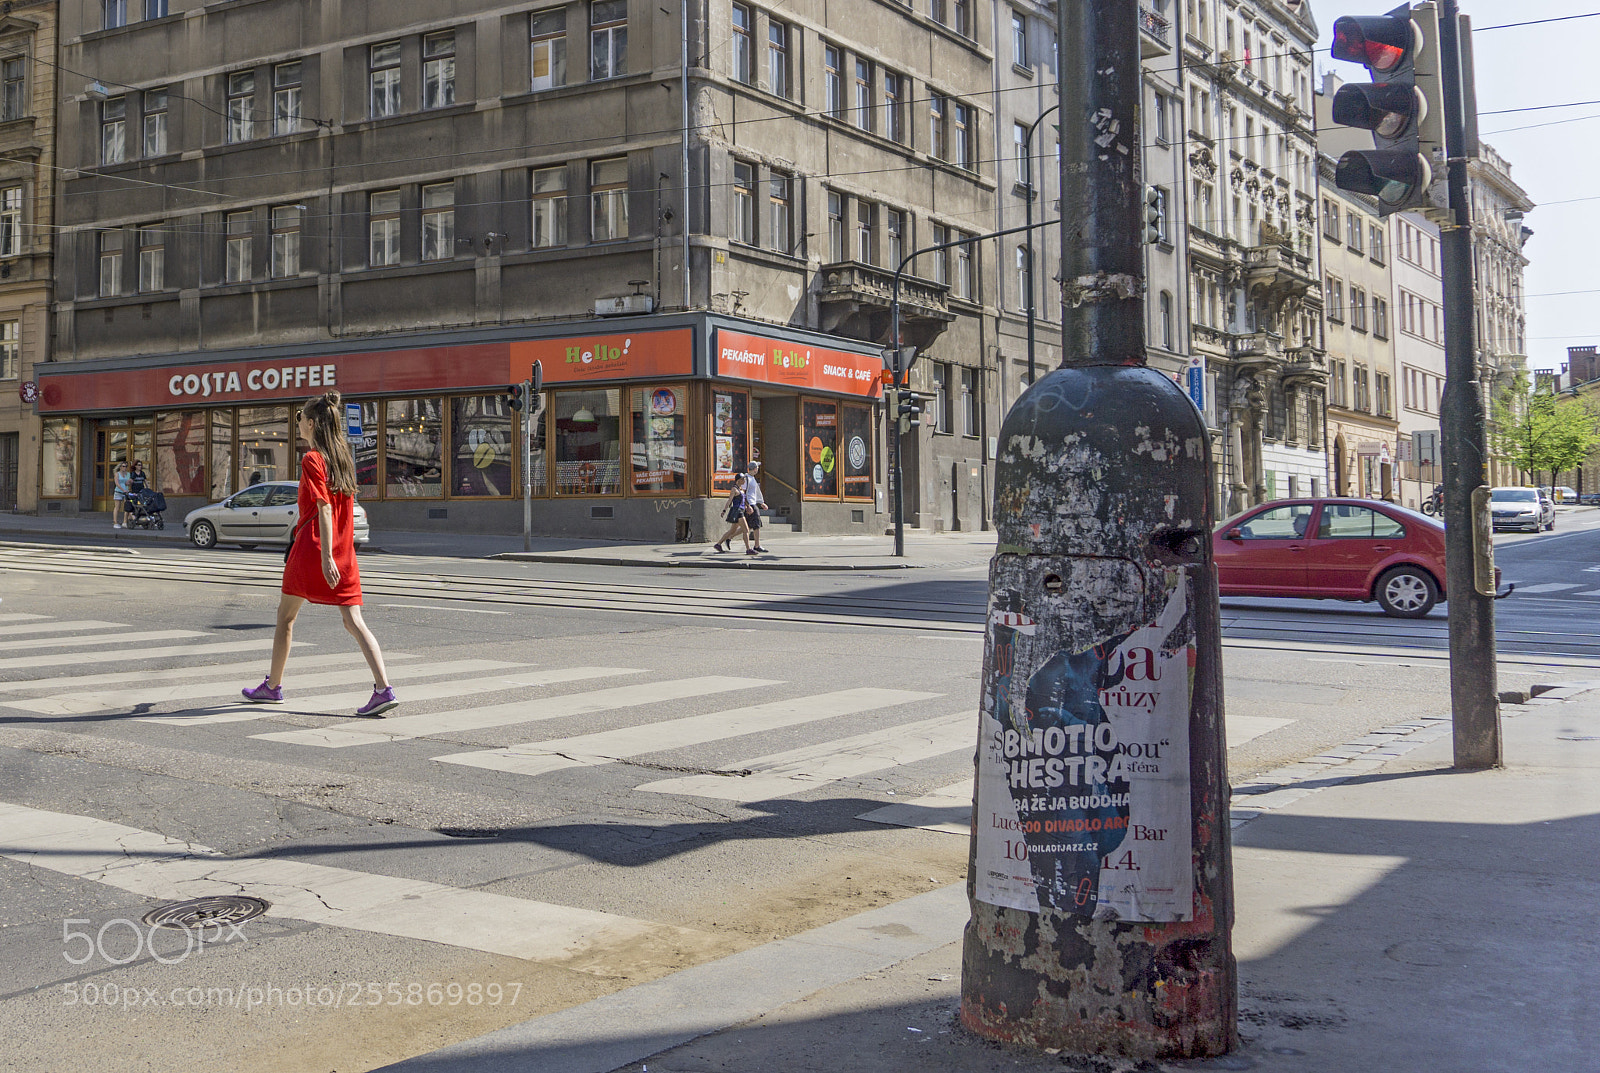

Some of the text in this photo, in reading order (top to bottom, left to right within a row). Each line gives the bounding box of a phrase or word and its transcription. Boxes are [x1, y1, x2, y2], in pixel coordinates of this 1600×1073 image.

[565, 338, 631, 364] Hello!
[721, 347, 766, 366] PEKAŘSTVÍ
[773, 348, 811, 369] Hello!
[823, 364, 847, 378] SNACK
[847, 368, 853, 379] &
[854, 369, 871, 381] CAFÉ
[169, 364, 336, 397] COSTA COFFEE
[1031, 794, 1046, 811] ŽE
[1045, 817, 1102, 833] DIVADLO
[1132, 825, 1167, 841] Bar
